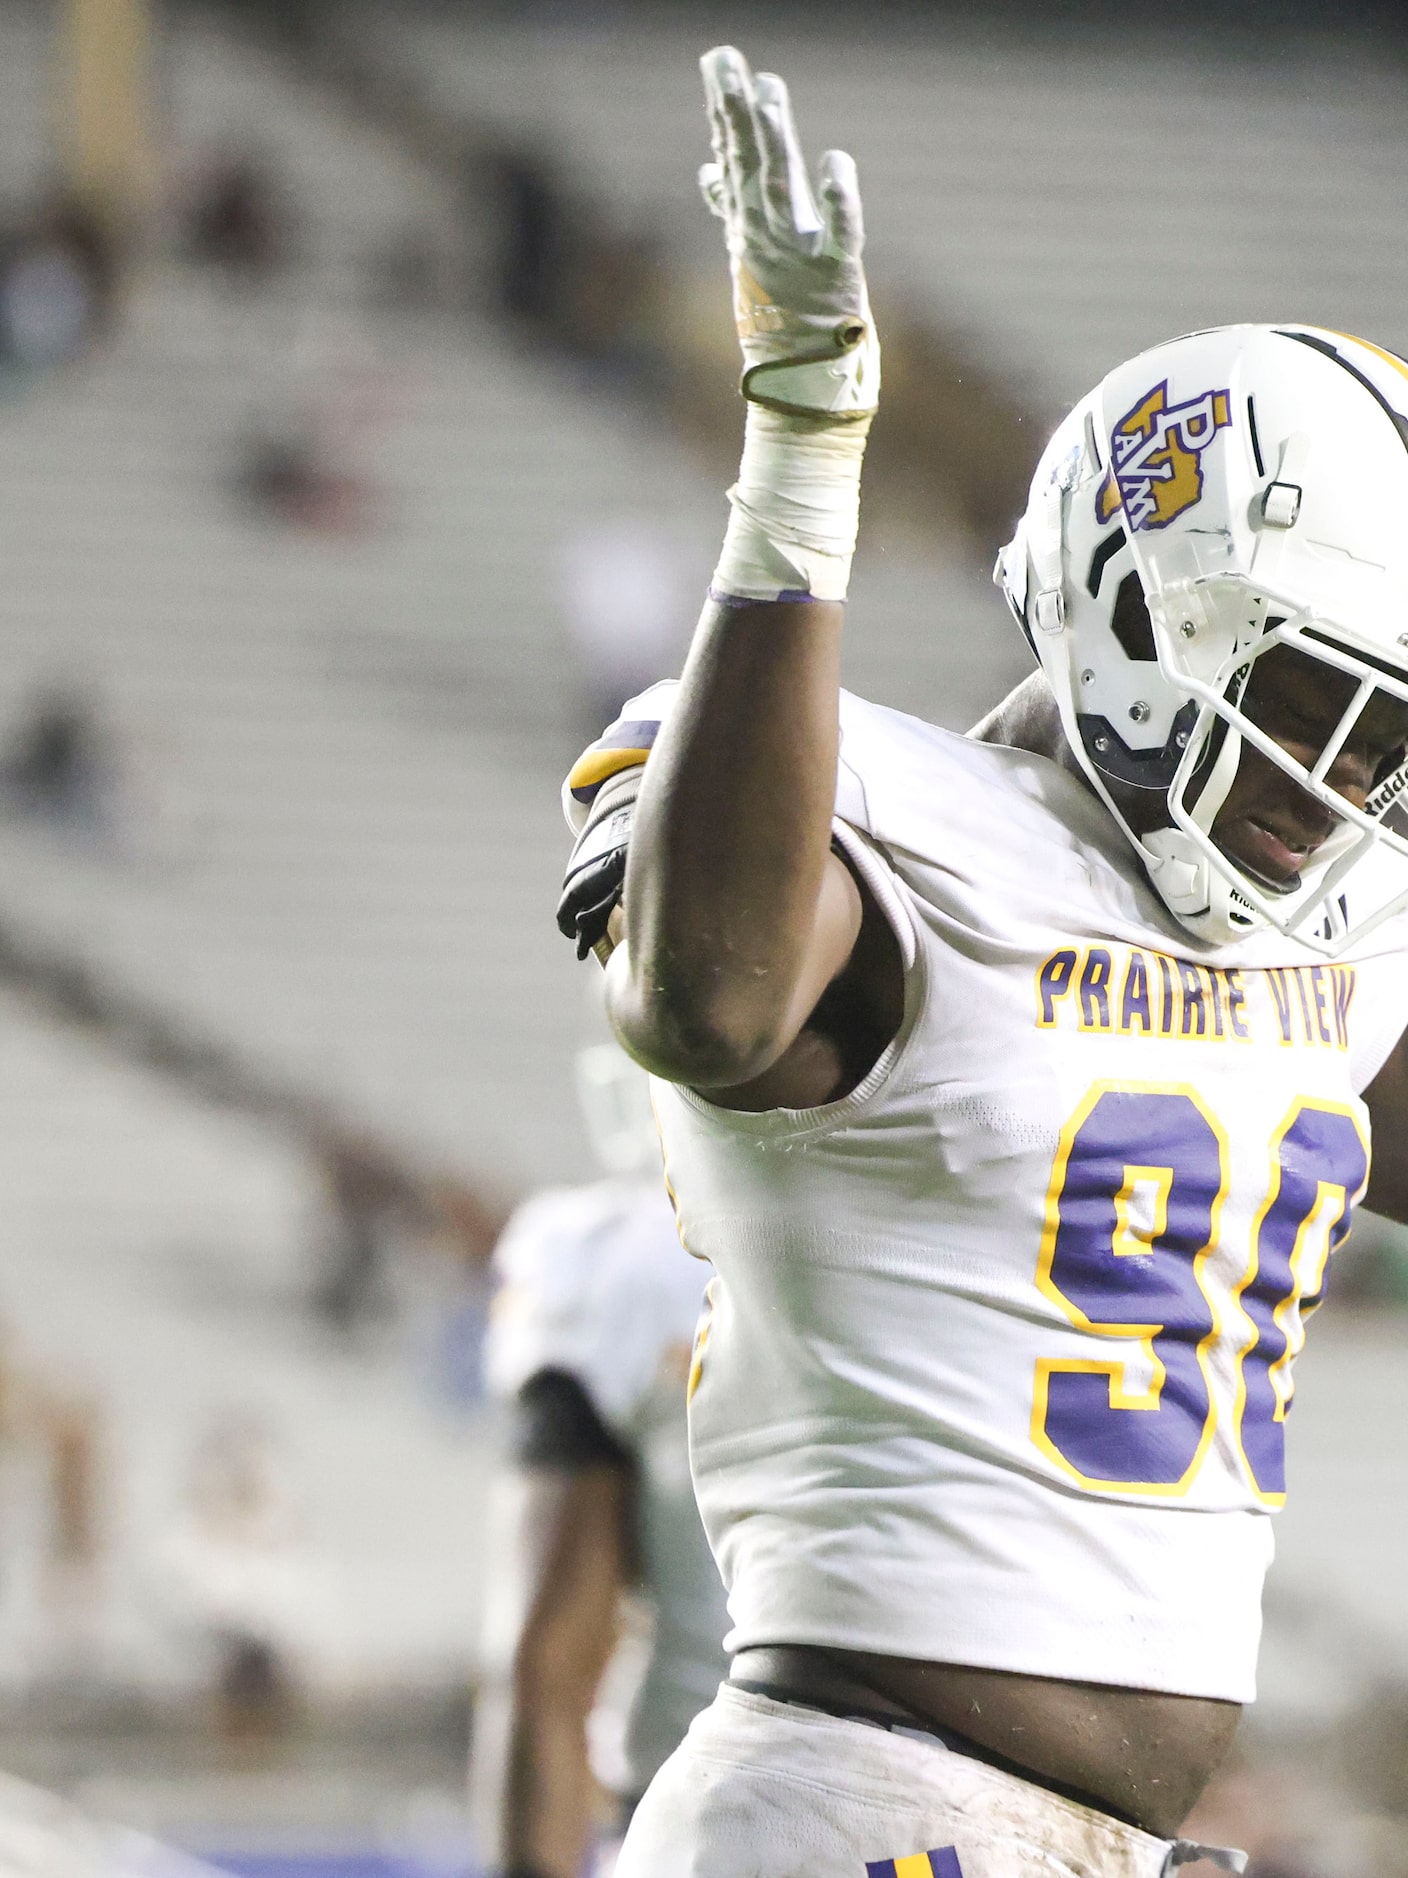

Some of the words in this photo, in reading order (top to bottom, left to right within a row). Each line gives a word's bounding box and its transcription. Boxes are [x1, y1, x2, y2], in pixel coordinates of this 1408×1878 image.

[1036, 945, 1252, 1043] PRAIRIE
[1264, 963, 1358, 1053] VIEW
[1030, 1078, 1373, 1508] 90
